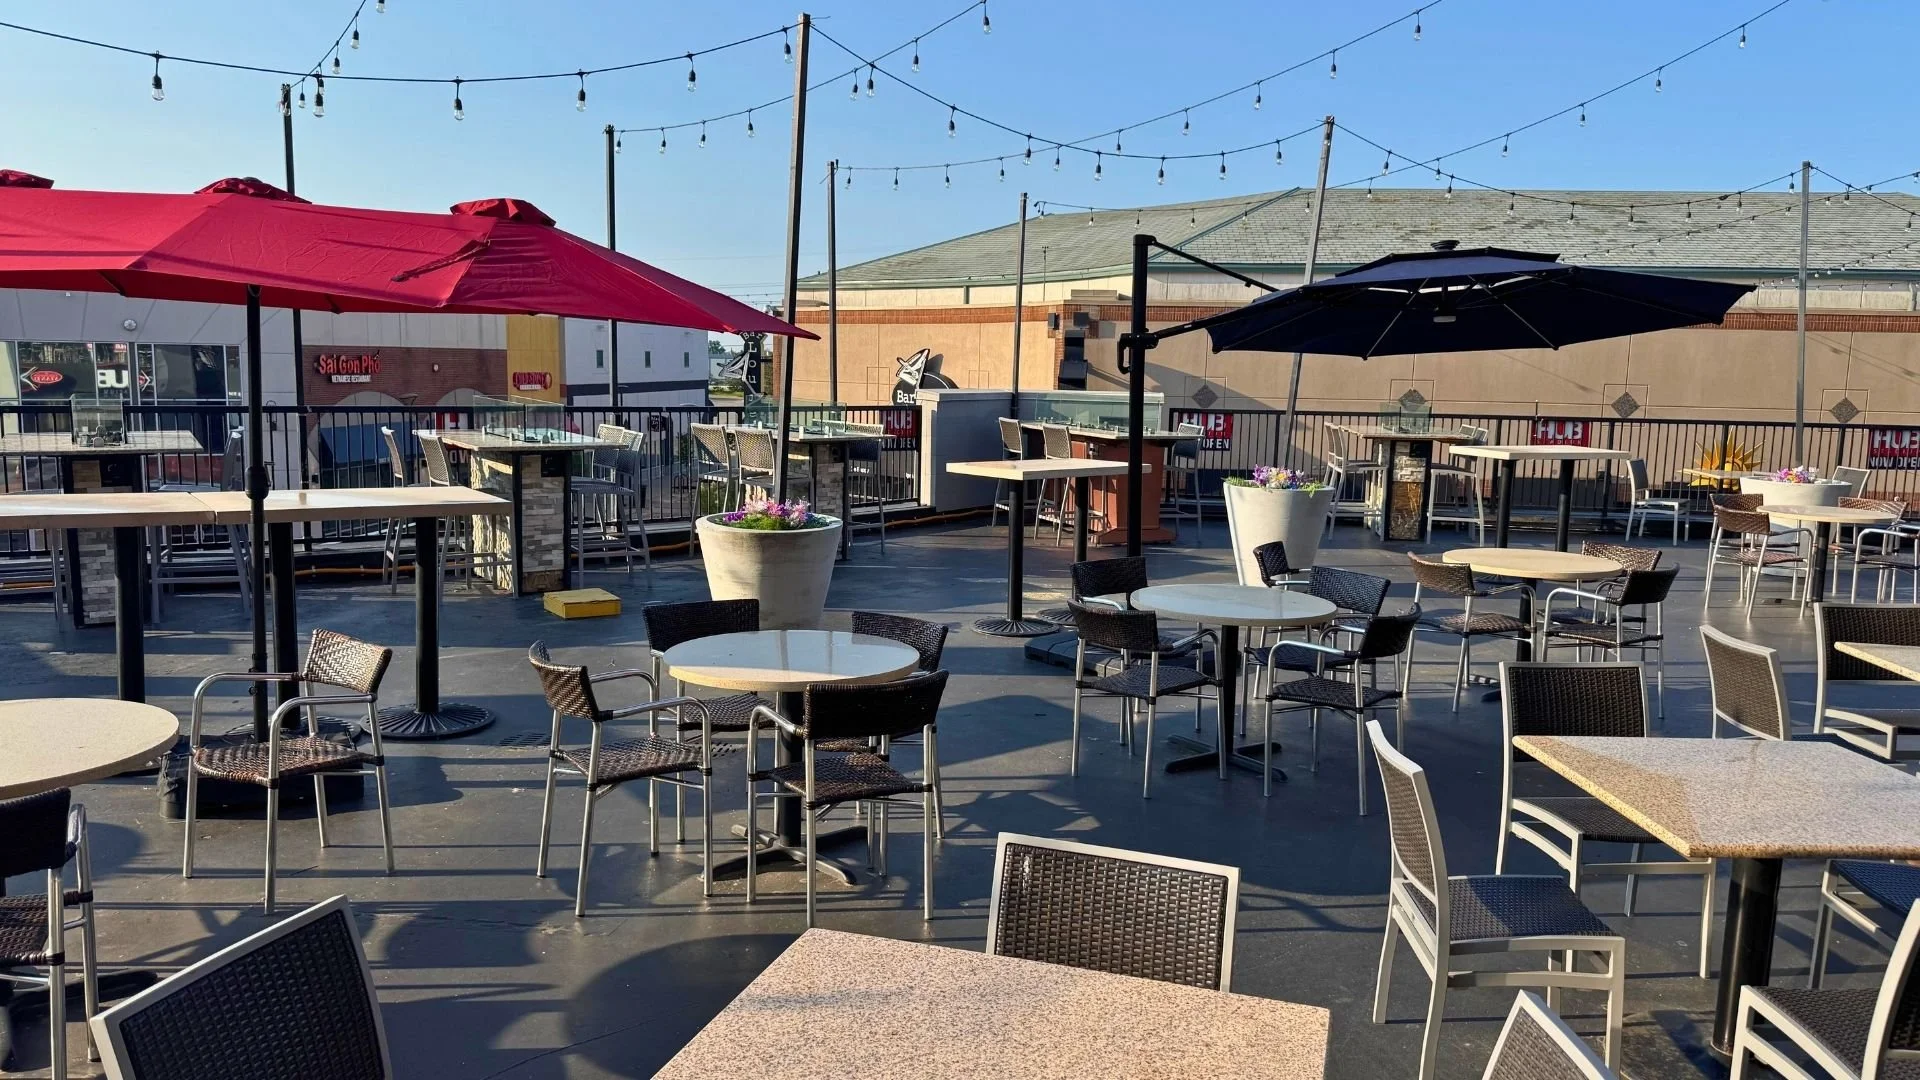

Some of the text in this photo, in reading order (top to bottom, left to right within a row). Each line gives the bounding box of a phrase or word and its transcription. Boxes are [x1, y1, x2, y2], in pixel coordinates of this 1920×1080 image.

[319, 354, 337, 374] Sai
[339, 355, 360, 374] Gon
[896, 390, 915, 403] Bar
[882, 410, 913, 429] HUB
[1536, 420, 1583, 440] HUB
[1872, 430, 1920, 449] HUB
[1202, 438, 1230, 449] OPEN
[1870, 456, 1894, 468] NOW
